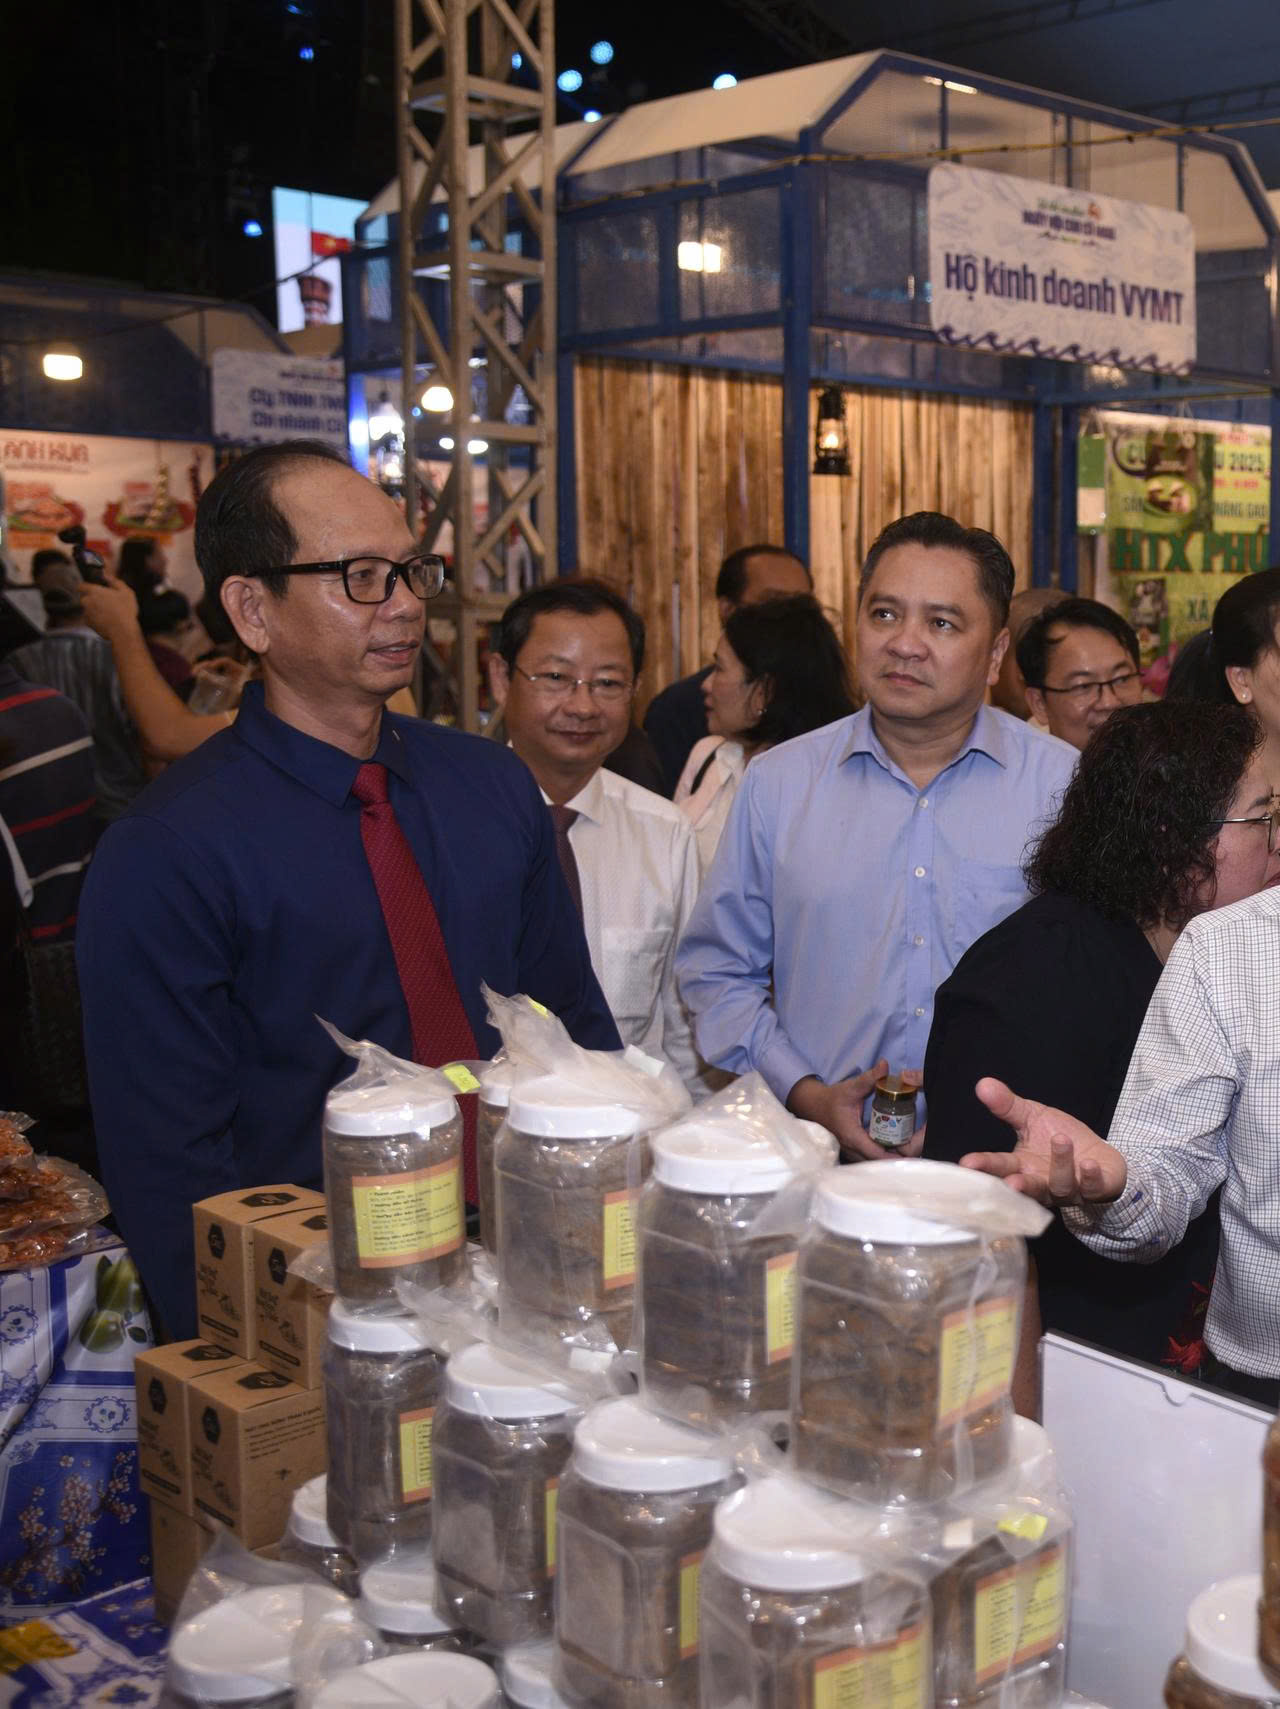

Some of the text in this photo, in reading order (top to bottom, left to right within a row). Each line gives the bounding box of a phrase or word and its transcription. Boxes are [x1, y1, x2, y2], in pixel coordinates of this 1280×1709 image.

[945, 253, 1184, 325] Hộ kinh doanh VYMT
